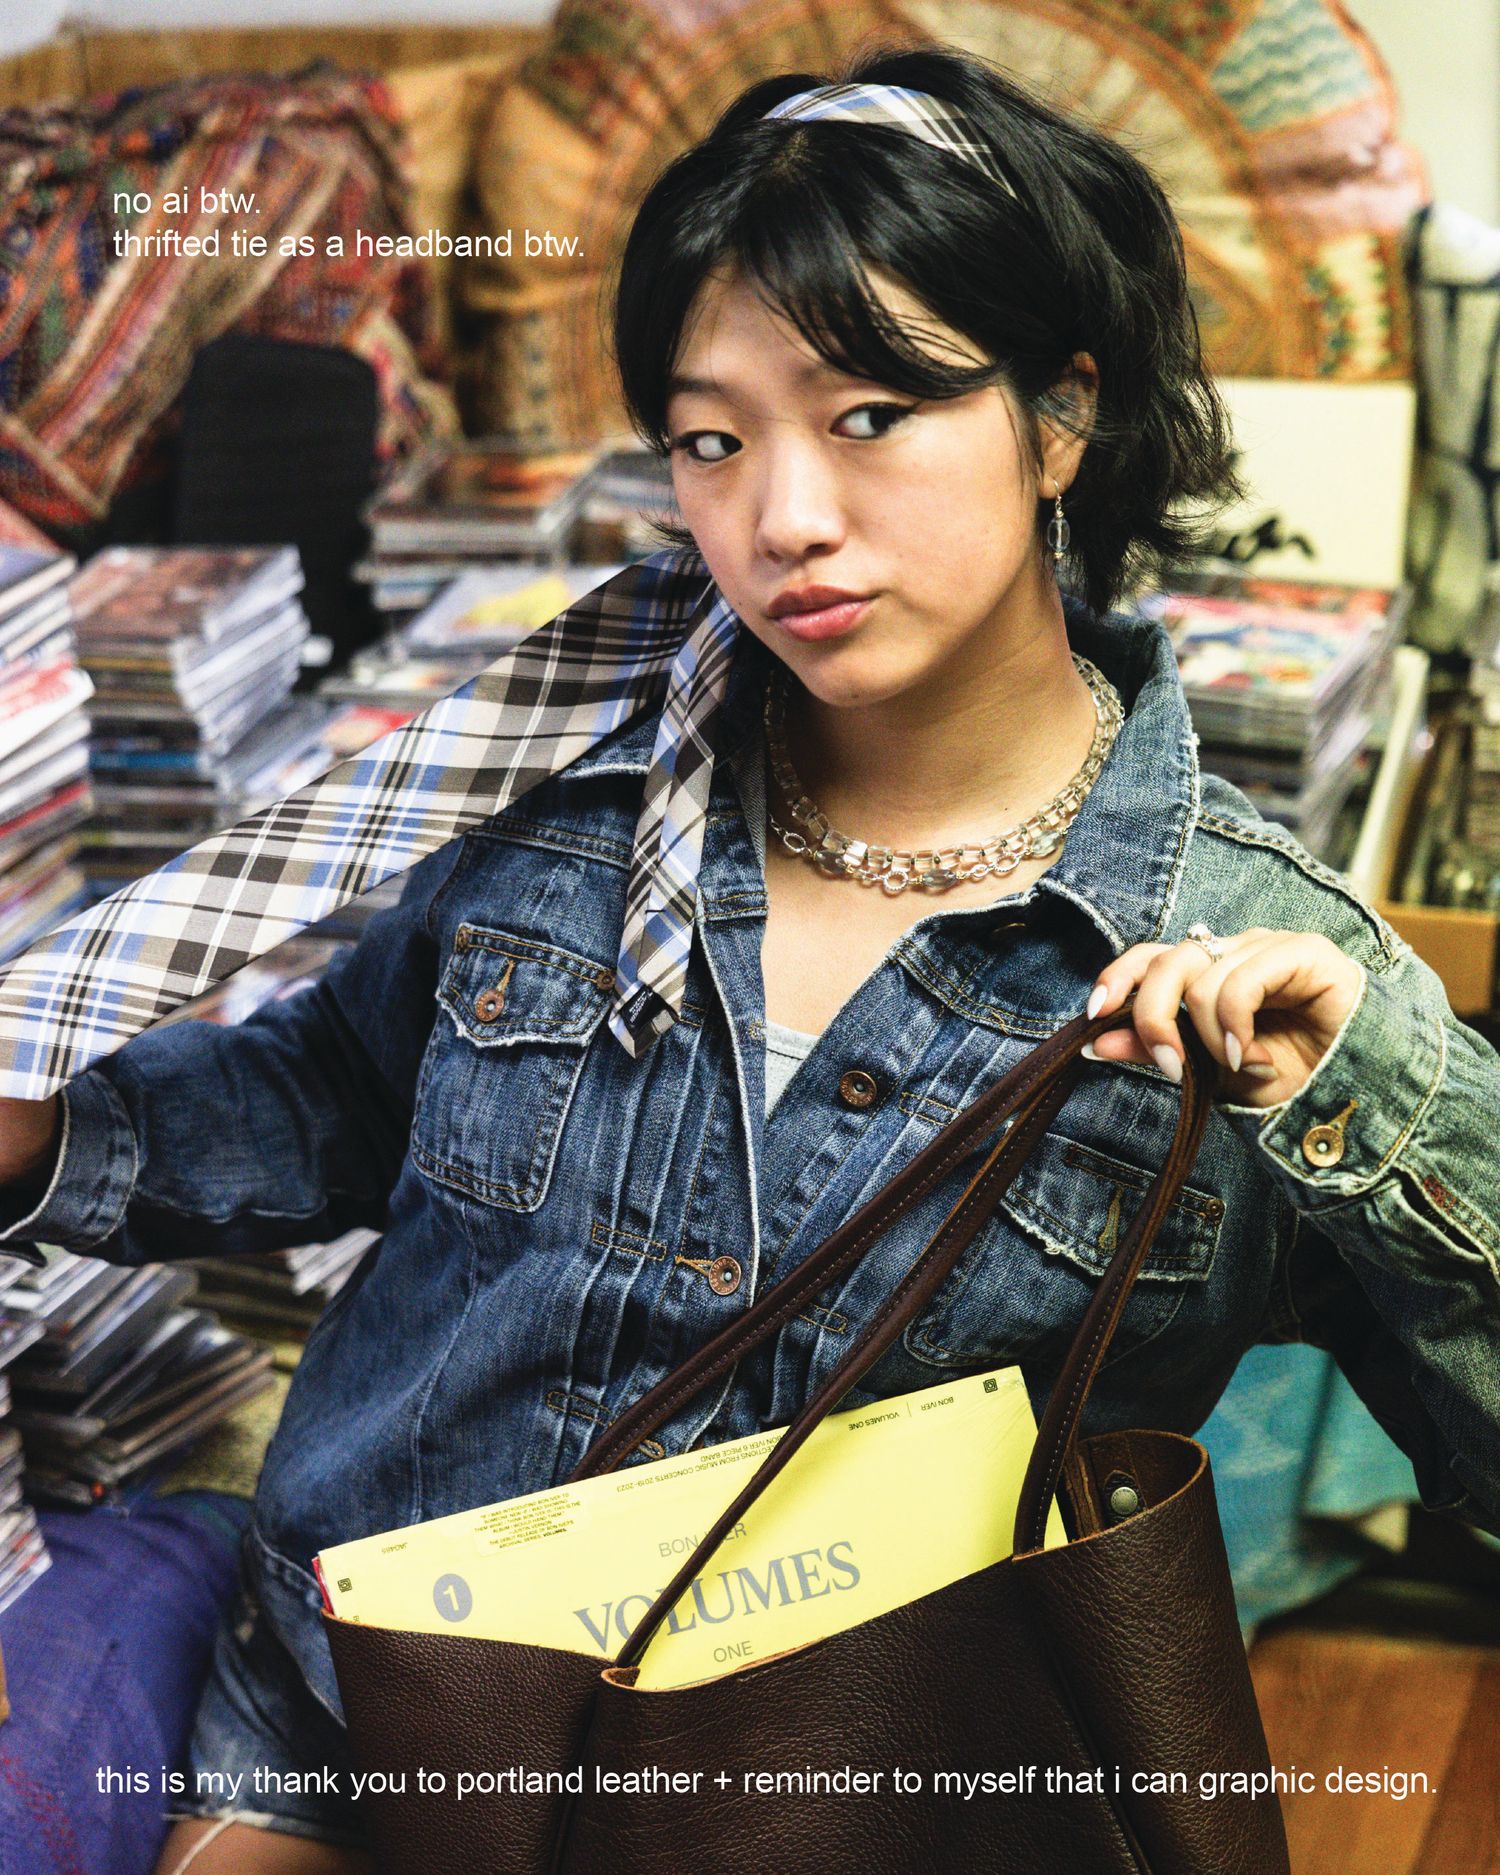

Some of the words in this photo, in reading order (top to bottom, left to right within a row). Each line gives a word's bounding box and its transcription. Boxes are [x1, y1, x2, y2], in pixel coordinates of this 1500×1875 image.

[938, 1396, 954, 1406] BON
[920, 1402, 938, 1412] IVER
[865, 1412, 900, 1426] VOLUMES
[848, 1421, 865, 1431] ONE
[748, 1440, 766, 1450] IVER
[700, 1453, 722, 1463] BAND
[723, 1447, 742, 1458] PIECE
[720, 1455, 740, 1466] FROM
[695, 1461, 721, 1473] MUSIC
[655, 1466, 694, 1483] CONCERTS
[658, 1534, 699, 1557] BON
[443, 1584, 460, 1612] 1
[573, 1541, 861, 1653] VOLUMES
[713, 1640, 755, 1663] ONE
